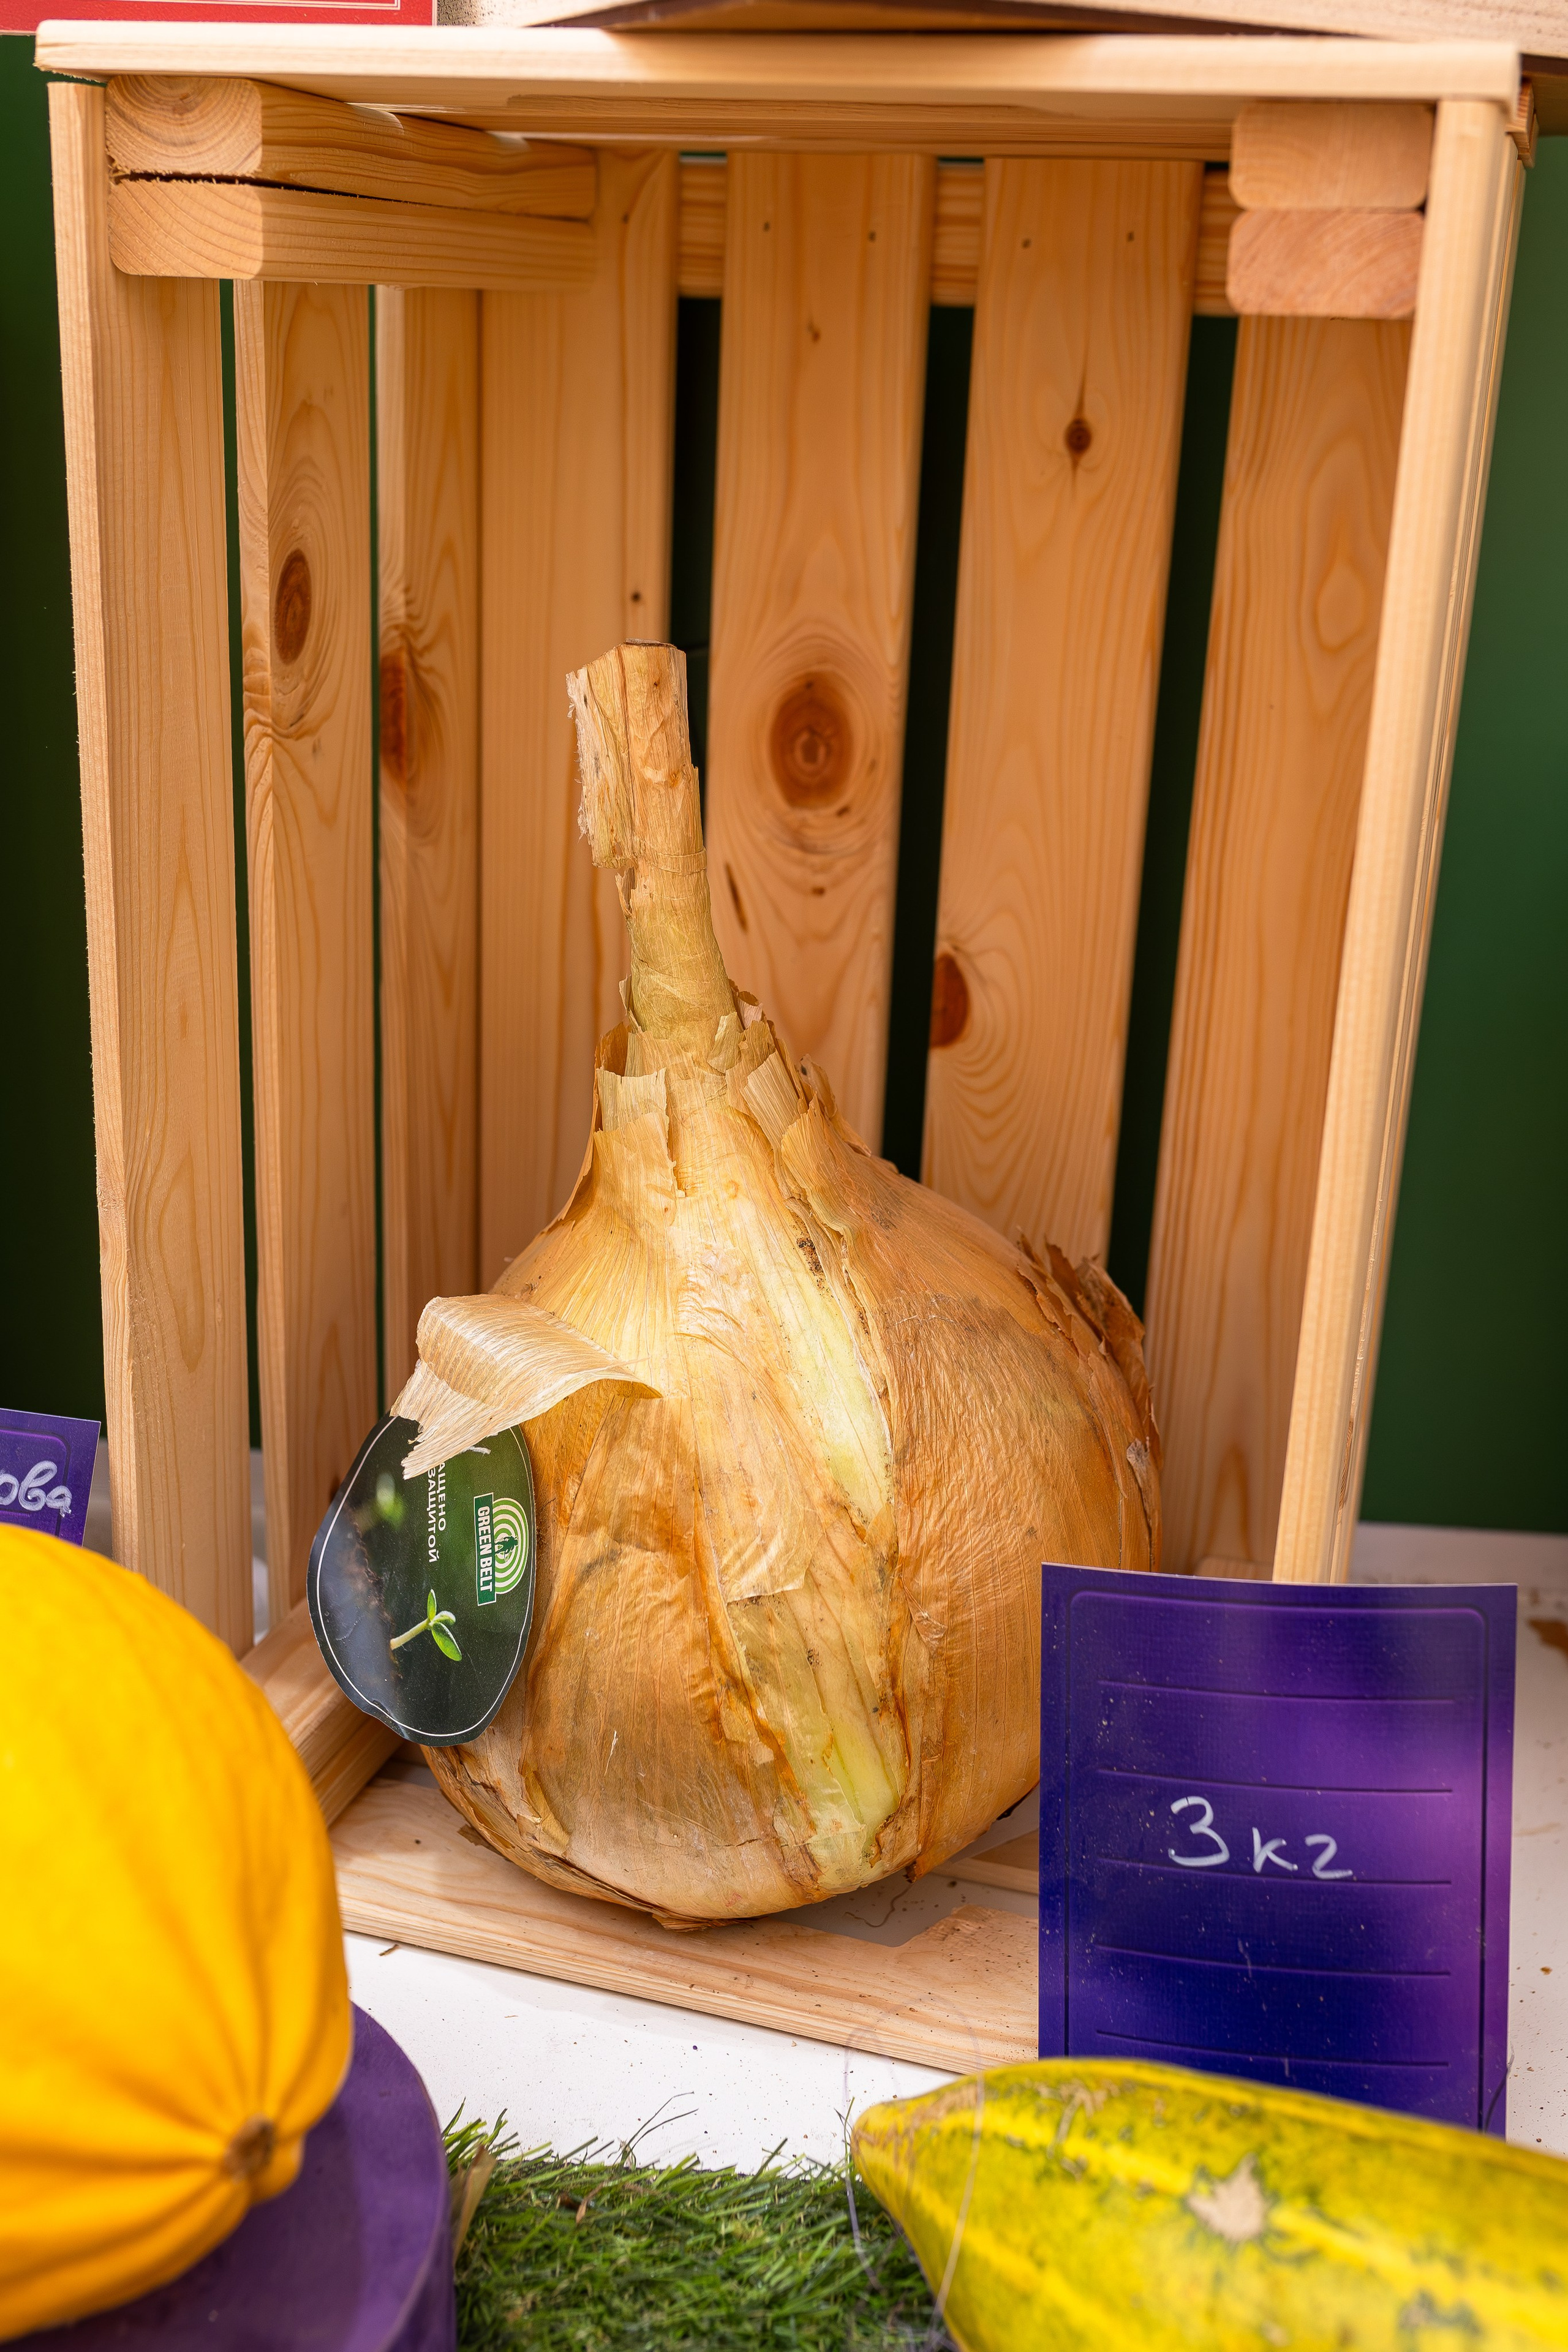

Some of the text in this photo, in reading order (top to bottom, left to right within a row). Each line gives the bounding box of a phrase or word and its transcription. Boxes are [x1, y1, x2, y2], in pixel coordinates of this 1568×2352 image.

[426, 1467, 440, 1563] ЗАЩИТОЙ
[477, 1506, 493, 1593] GREEN BELT
[1167, 1795, 1230, 1868] 3
